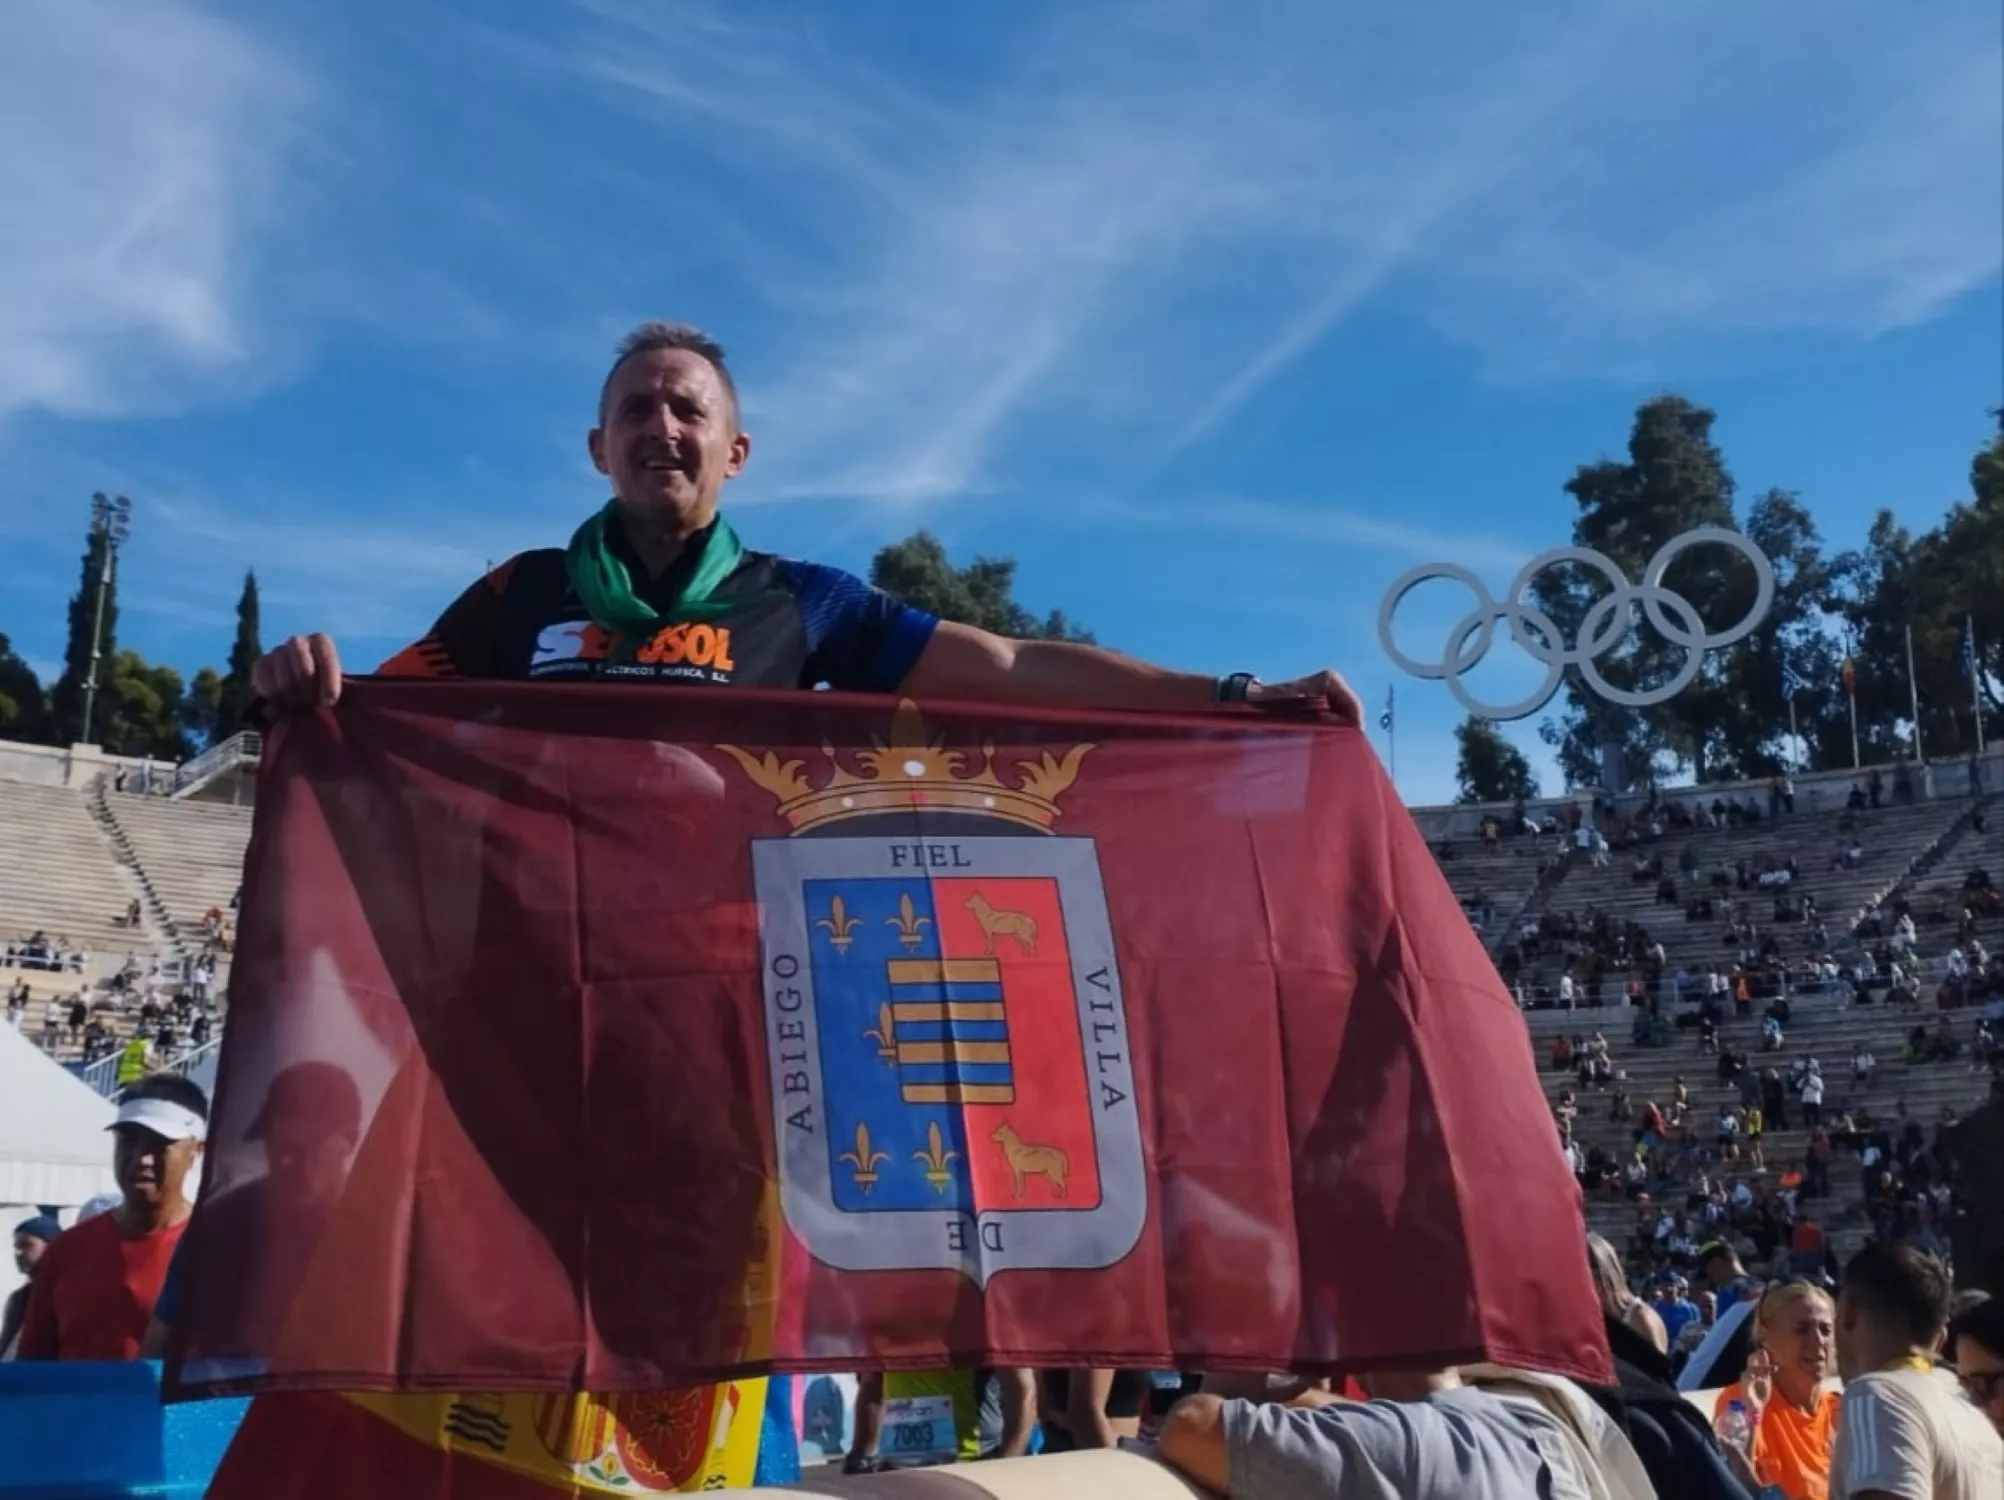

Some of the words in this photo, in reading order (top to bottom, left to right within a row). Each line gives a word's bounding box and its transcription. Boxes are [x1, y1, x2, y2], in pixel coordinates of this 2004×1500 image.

[531, 620, 734, 672] SEUSOL
[890, 844, 971, 868] FIEL
[772, 953, 813, 1134] ABIEGO
[1085, 966, 1127, 1111] VILLA
[946, 1220, 1004, 1252] DE
